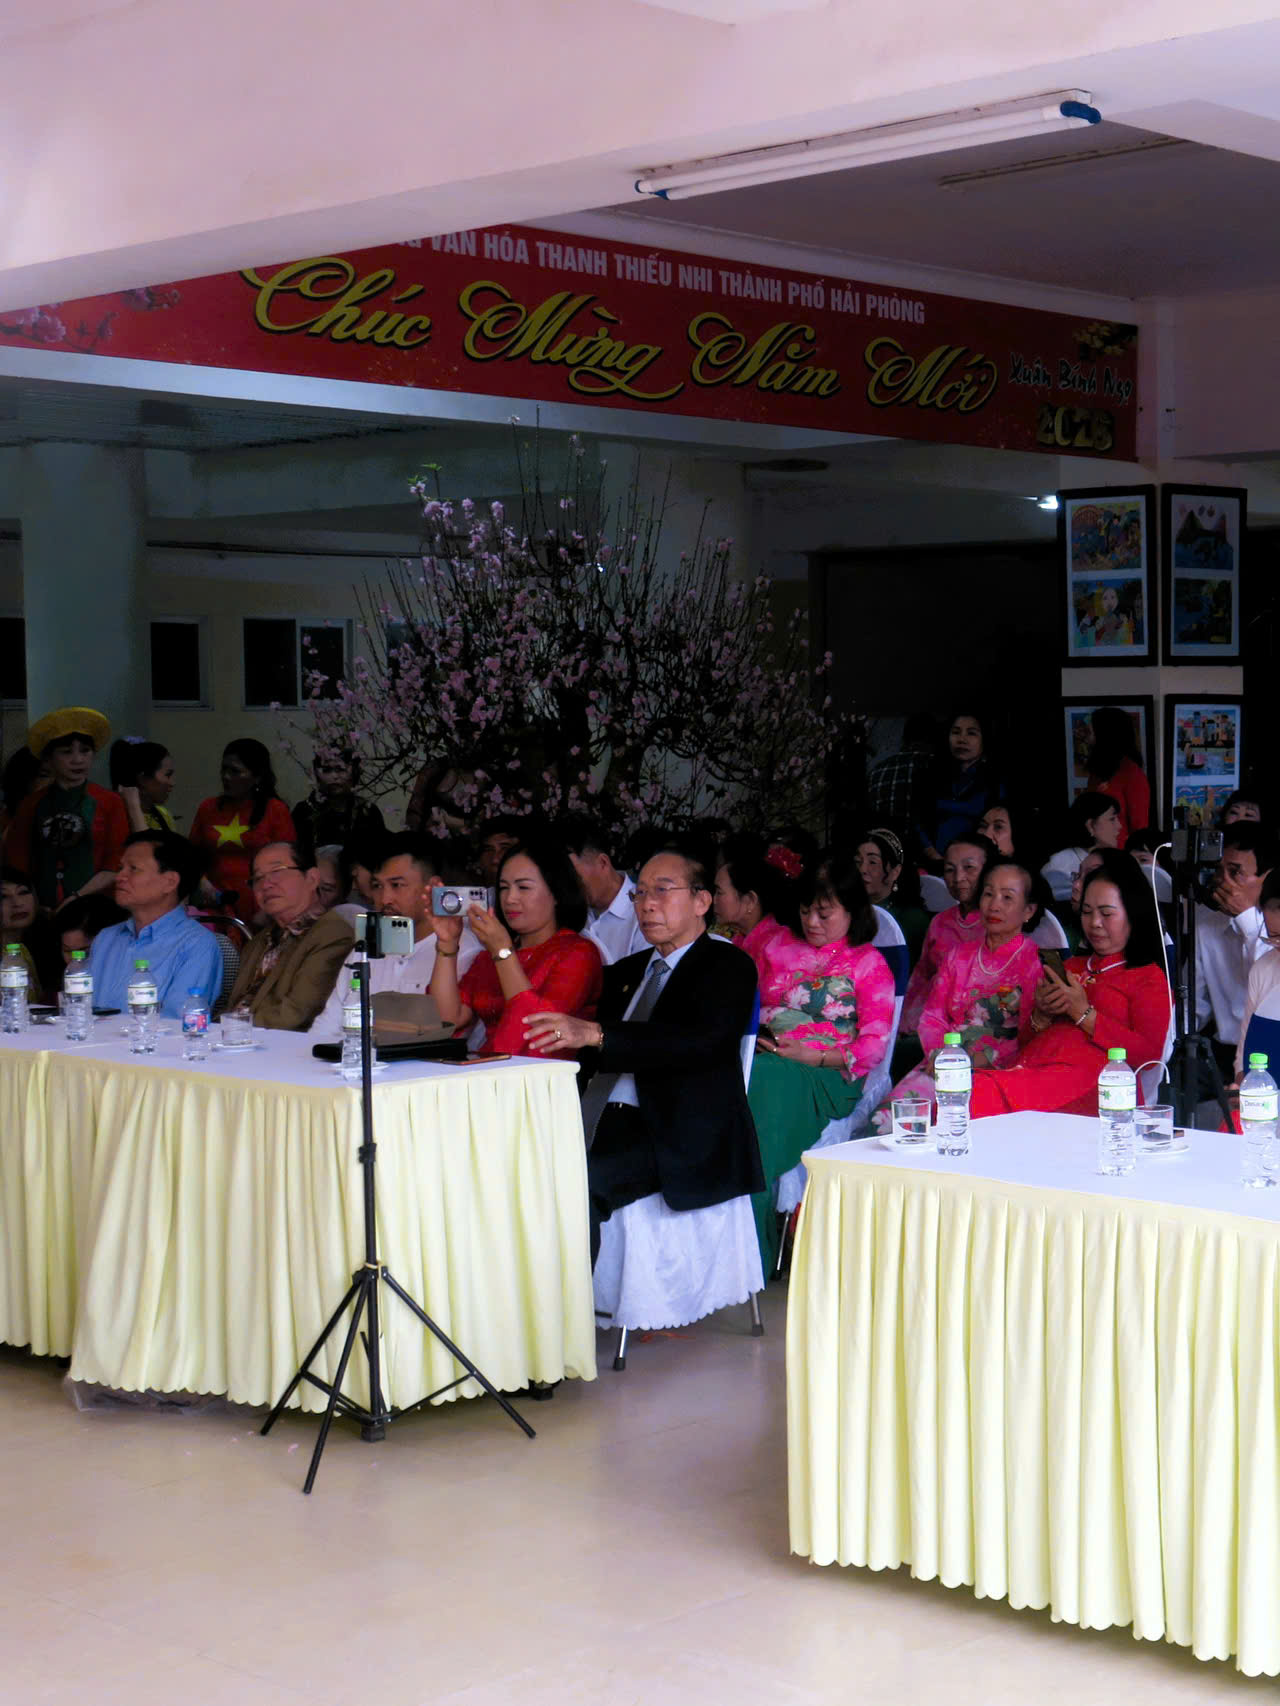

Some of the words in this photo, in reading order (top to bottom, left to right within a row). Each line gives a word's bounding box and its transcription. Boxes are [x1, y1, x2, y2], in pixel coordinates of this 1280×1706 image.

[238, 257, 431, 349] Chúc
[459, 280, 685, 400] Mừng
[687, 312, 841, 398] Năm
[864, 336, 999, 413] Mới
[483, 231, 529, 265] HÓA
[536, 241, 608, 277] THANH
[613, 252, 673, 286] THIẾU
[678, 264, 713, 293] NHI
[719, 271, 783, 305] THÀNH
[787, 279, 826, 310] PHỐ
[830, 283, 861, 314] HẢI
[866, 293, 926, 325] PHÒNG
